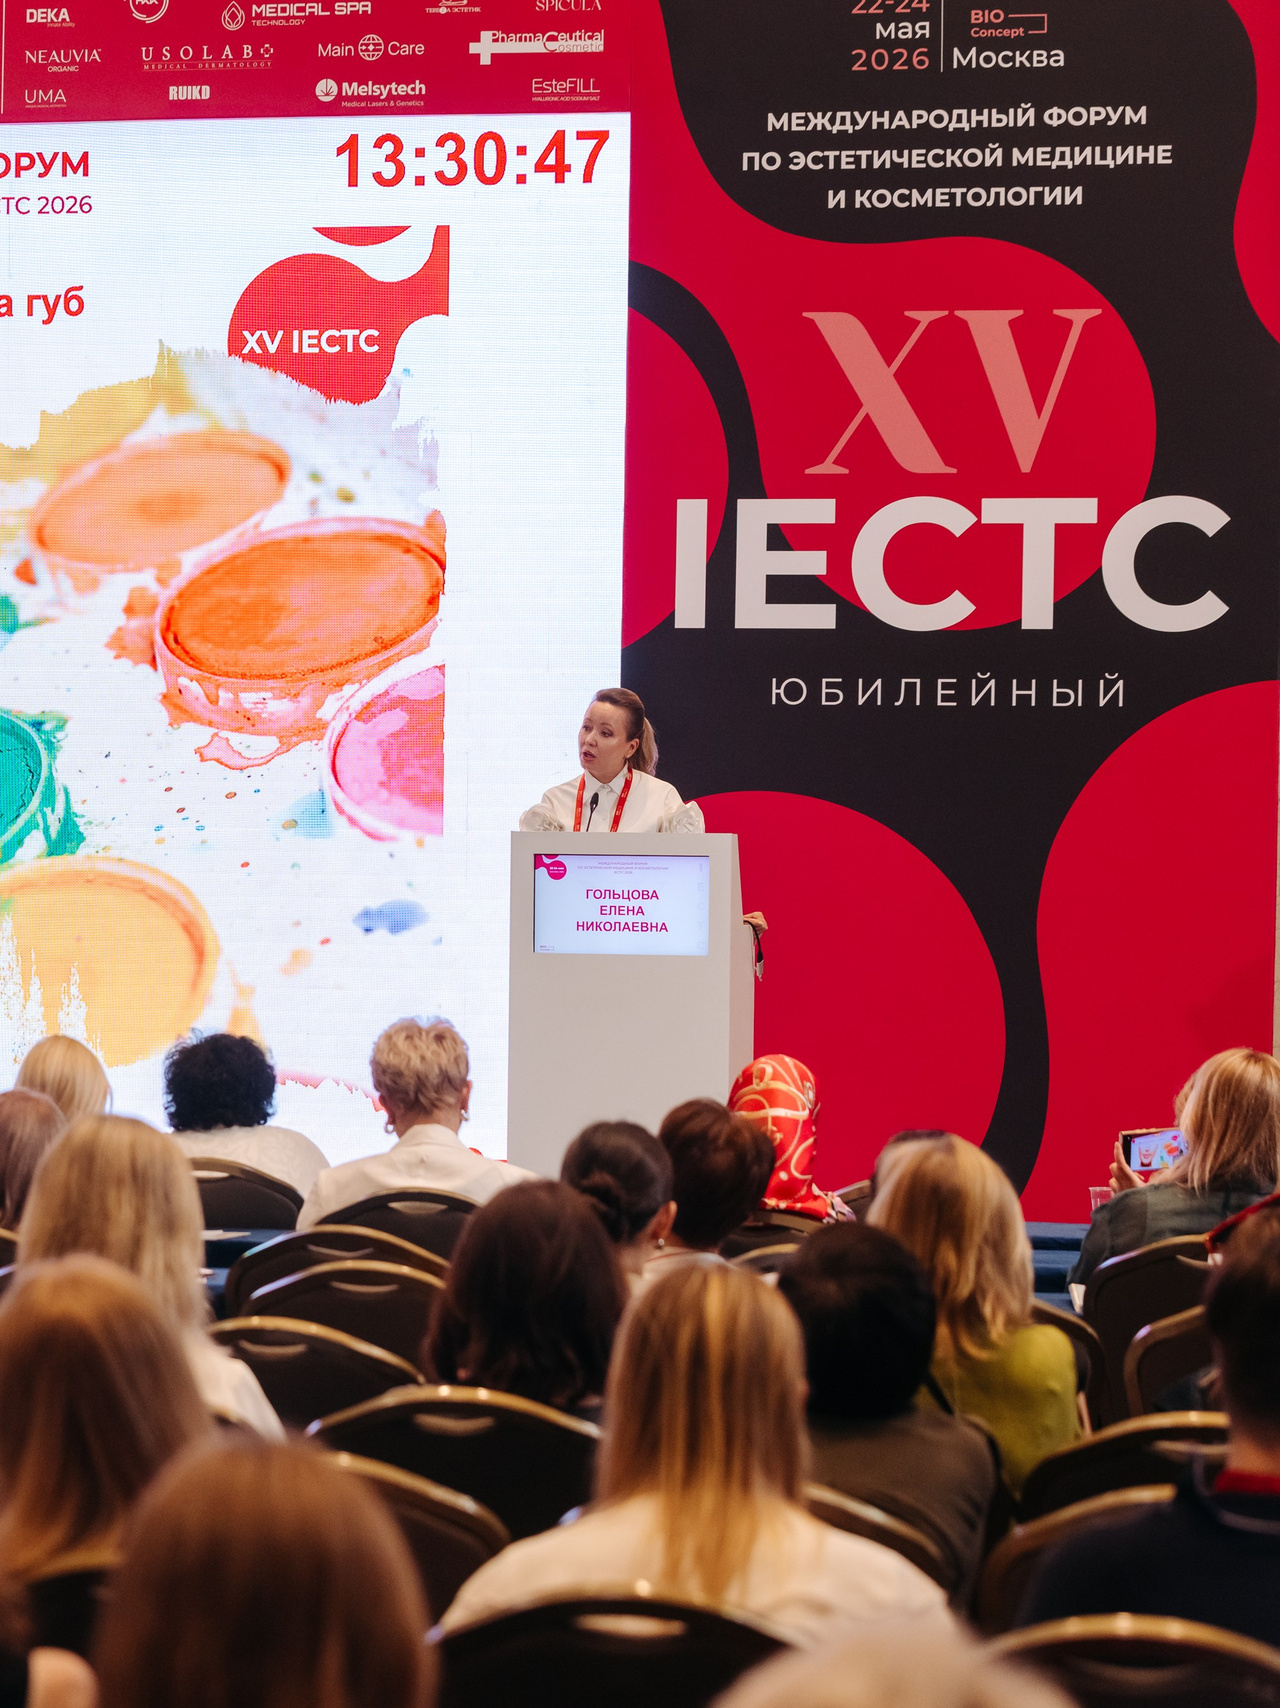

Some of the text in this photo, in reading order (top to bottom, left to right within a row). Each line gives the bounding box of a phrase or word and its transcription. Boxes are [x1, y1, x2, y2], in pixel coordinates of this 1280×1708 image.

[252, 1, 372, 17] MEDICAL SPA
[535, 0, 602, 11] SPICULA
[26, 8, 70, 23] DEKA
[251, 18, 306, 26] TECHNOLOGY
[970, 9, 1005, 24] BIO
[875, 21, 930, 39] мая
[970, 27, 1025, 39] Concept
[25, 48, 101, 64] NEAUVIA
[141, 44, 253, 61] USOLAB
[318, 41, 425, 57] Main Care
[198, 61, 272, 69] DERMATOLOGY
[851, 48, 930, 71] 2026
[953, 47, 1065, 69] Москва
[47, 65, 79, 73] ORGANIC
[342, 80, 426, 99] Melsytech
[532, 78, 600, 93] EsteFILL
[24, 88, 67, 104] UMA
[766, 103, 1147, 133] МЕЖДУНАРОДНЫЙ ФОРУМ
[336, 129, 611, 188] 13:30:47
[741, 143, 1173, 171] ПО ЭСТЕТИЧЕСКОЙ МЕДИЦИНЕ
[827, 185, 1084, 209] И КОСМЕТОЛОГИИ
[37, 195, 93, 216] 2026
[25, 285, 85, 323] губ
[241, 328, 381, 354] XV IECTC
[801, 308, 1103, 475] XV
[674, 495, 1231, 632] IECTC
[770, 671, 1125, 708] ЮБИЛЕЙНЫЙ
[586, 889, 659, 901] ГОЛЬЦОВА
[600, 905, 645, 916] ЕЛЕНА
[576, 921, 668, 933] НИКОЛАЕВНА
